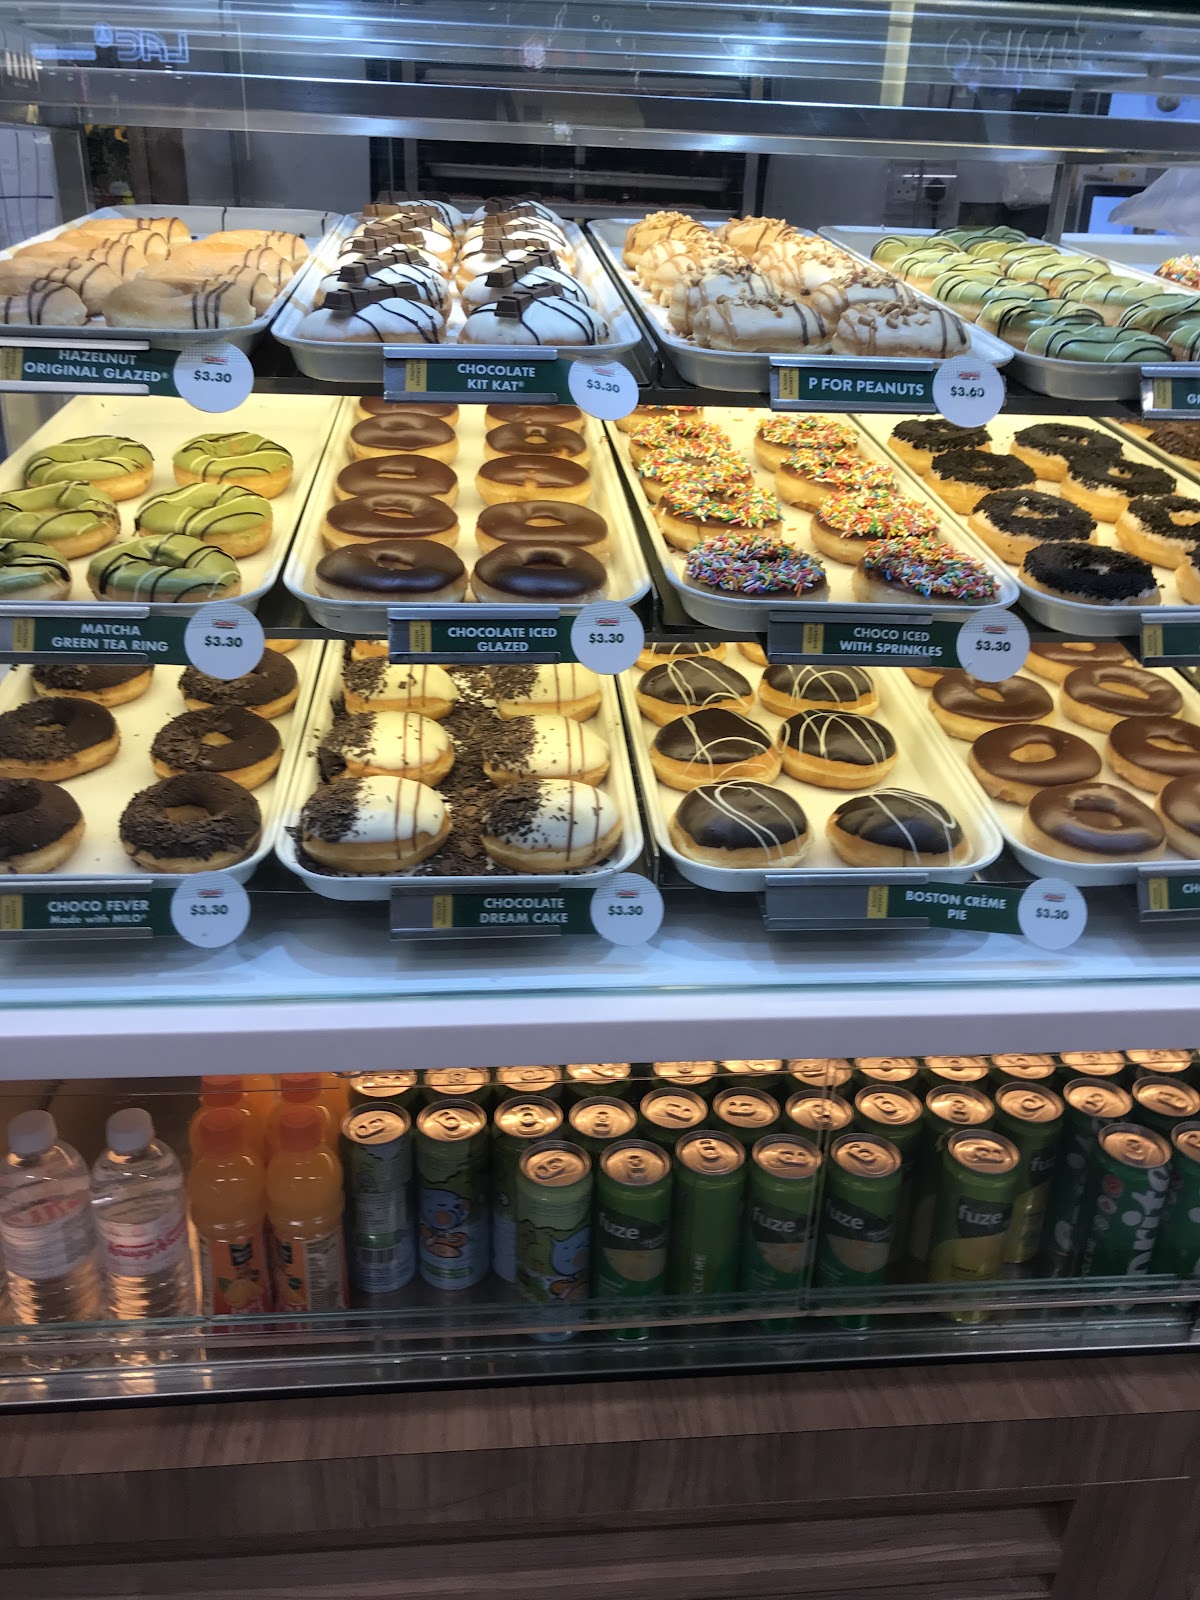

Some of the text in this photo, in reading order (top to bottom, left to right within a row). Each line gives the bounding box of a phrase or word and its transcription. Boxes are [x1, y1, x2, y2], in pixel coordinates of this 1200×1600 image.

[58, 350, 137, 366] HAZELNUT
[23, 362, 99, 378] ORIGINAL
[193, 370, 232, 384] $3.30
[457, 363, 536, 378] CHOCOLATE
[467, 379, 488, 390] KIT
[586, 378, 621, 394] $3.30
[808, 377, 925, 397] P FOR PEANUTS
[949, 386, 986, 398] $3.60
[80, 622, 141, 637] MATCHA
[447, 626, 558, 639] CHOCOLATE ICED
[852, 627, 931, 643] CHOCO ICED
[51, 637, 170, 653] GREEN TEA RING
[204, 634, 244, 649] $3.30
[588, 632, 625, 645] $3.30
[975, 638, 1012, 653] $3.30
[476, 641, 530, 653] GLAZED
[839, 640, 943, 658] WITH SPRINKLES
[483, 897, 565, 910] CHOCOLATE
[905, 890, 961, 906] BOSTON
[47, 900, 150, 913] CHOCO FEVER
[190, 904, 229, 916] $3.30
[608, 905, 643, 917] $3.30
[1035, 907, 1069, 920] $3.30
[479, 912, 568, 924] DREAM CAKE
[947, 908, 968, 921] PIE
[959, 1204, 1004, 1226] fuze
